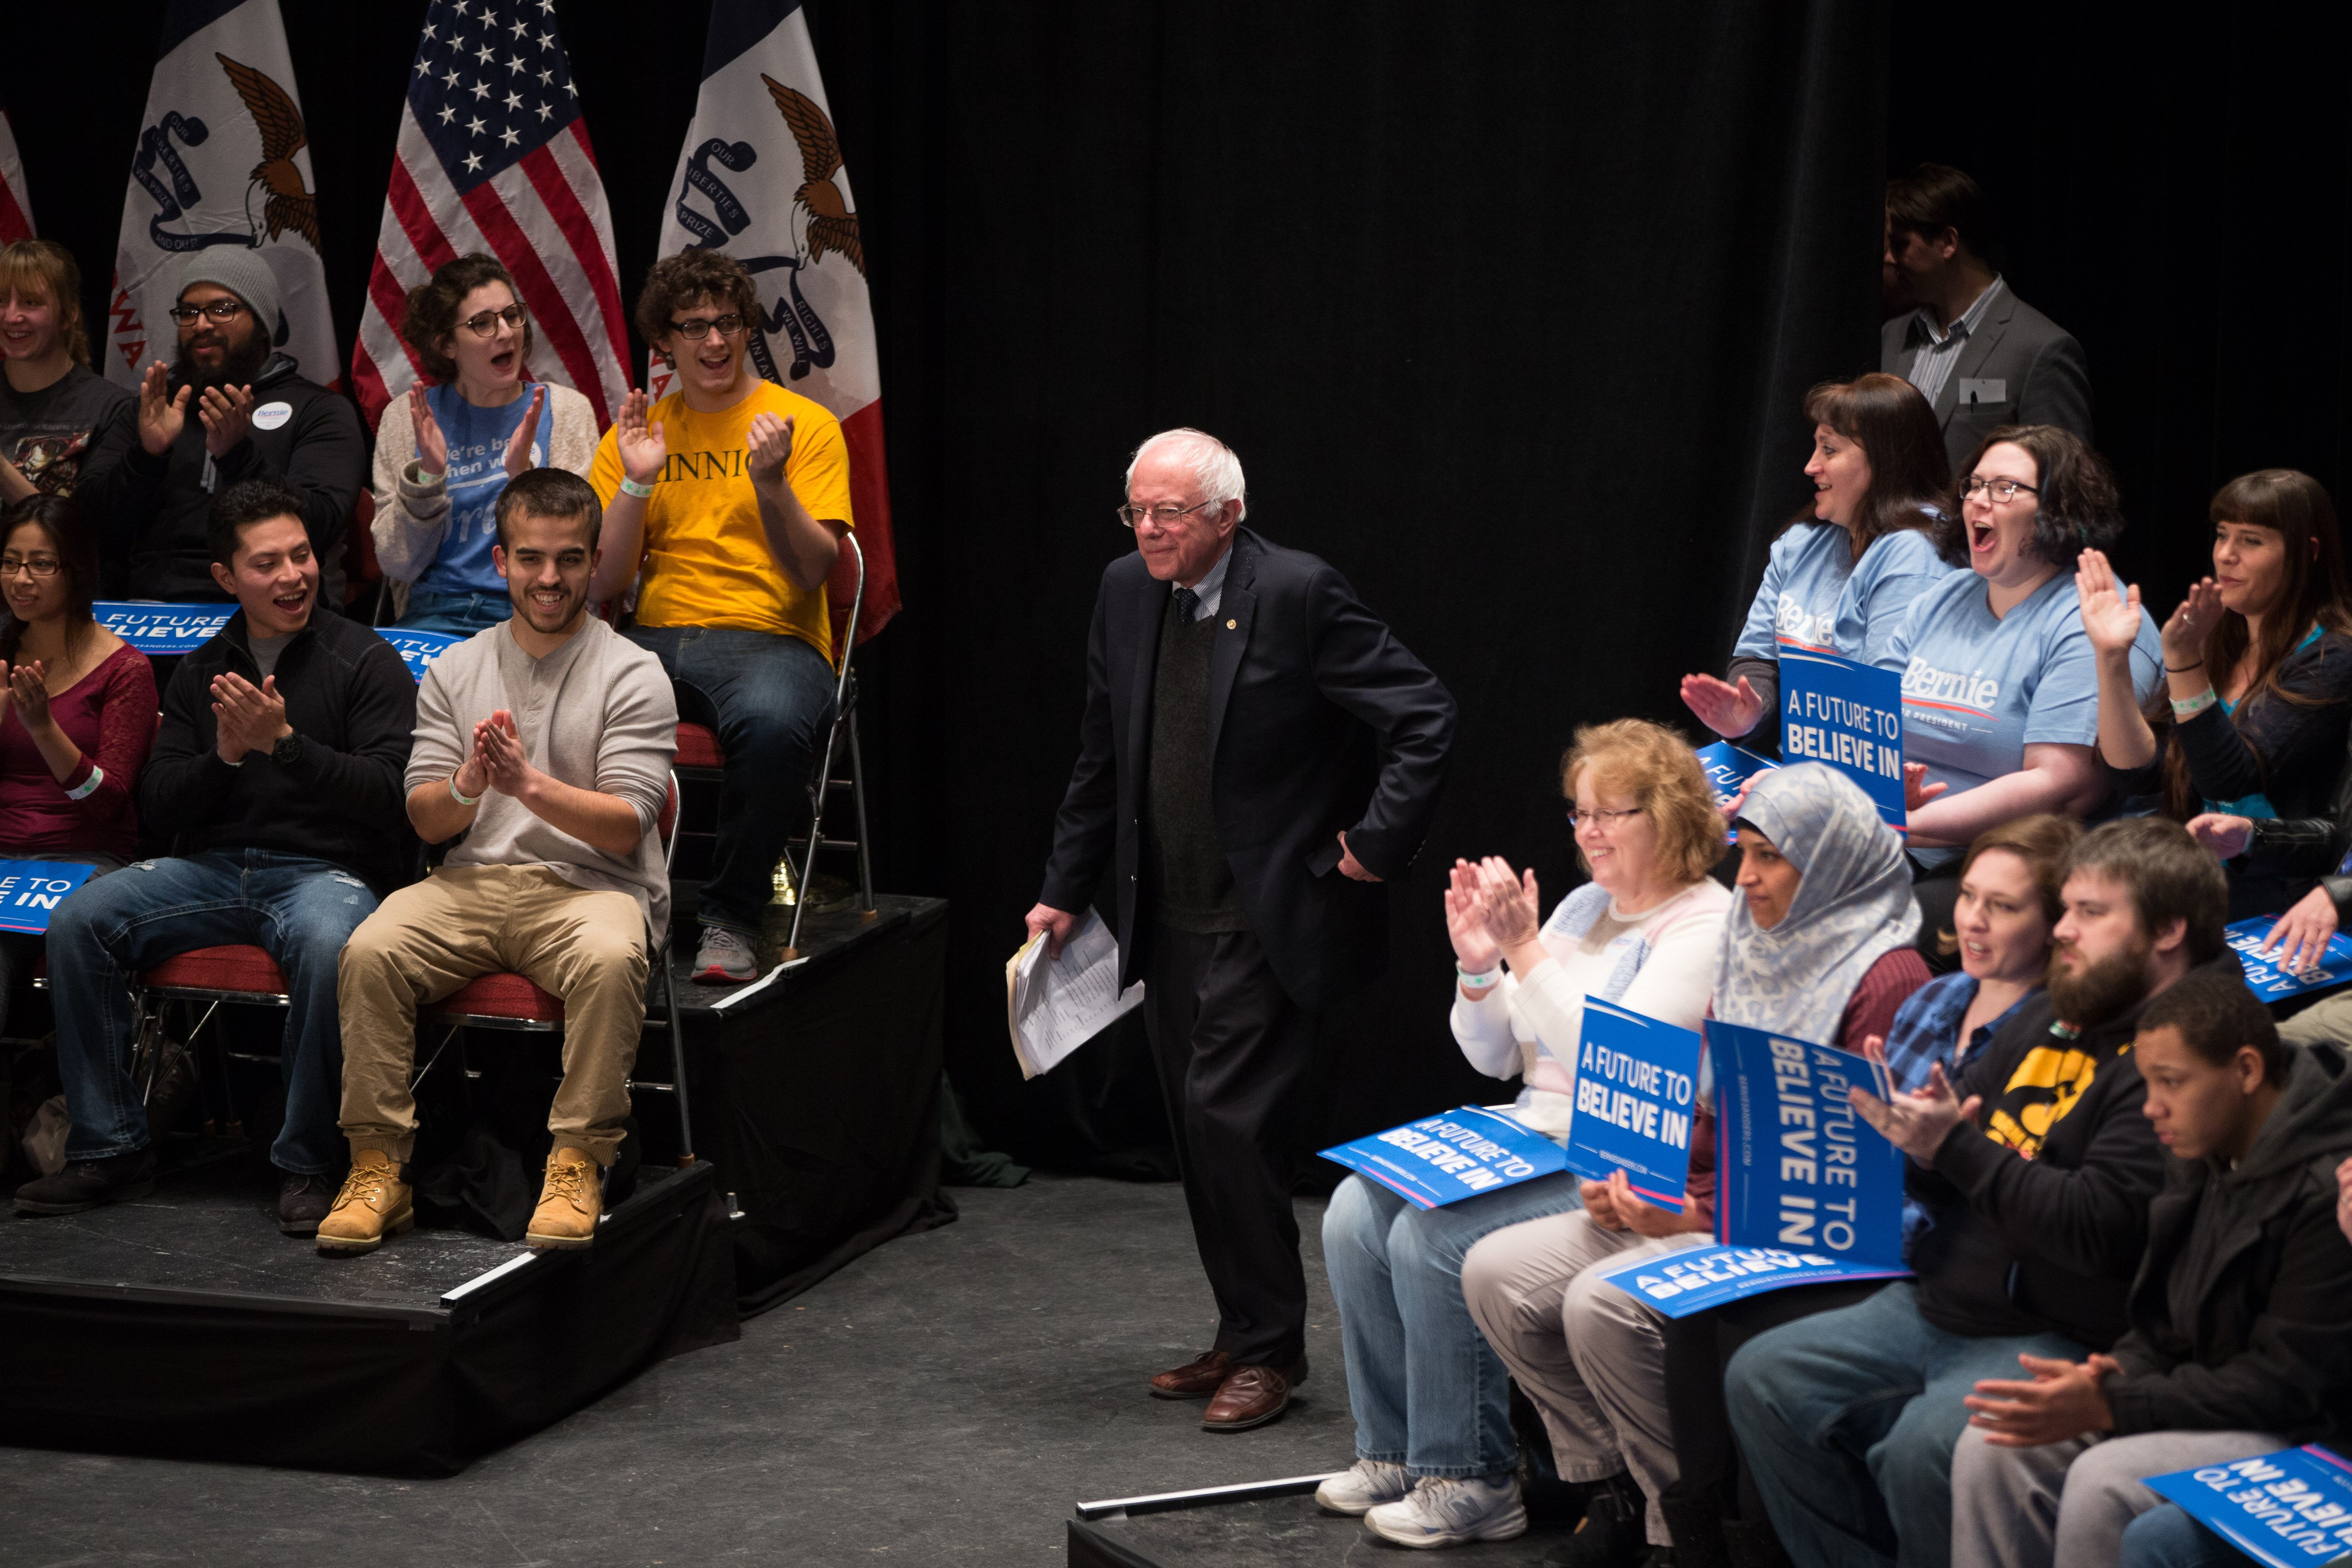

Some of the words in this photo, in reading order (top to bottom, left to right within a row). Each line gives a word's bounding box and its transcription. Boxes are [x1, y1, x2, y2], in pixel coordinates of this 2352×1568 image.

[170, 116, 189, 139] OUR
[711, 142, 735, 166] OUR
[687, 167, 739, 218] IBERTIES
[156, 234, 173, 249] AND
[680, 210, 715, 238] PRIZE
[110, 268, 147, 371] WA
[782, 309, 799, 332] WE
[793, 332, 807, 367] WILL
[796, 301, 829, 350] RIGHTS
[446, 444, 486, 461] e're
[447, 461, 482, 478] hen
[654, 449, 751, 484] INNI
[106, 613, 232, 626] FUTURE
[1900, 656, 1999, 709] Bernie
[1788, 689, 1802, 716] A
[1806, 692, 1872, 733] FUTURE
[1874, 710, 1898, 740] TO
[1913, 712, 1968, 731] PRESIDENT
[1788, 723, 1875, 773] BELIEVE
[1878, 745, 1900, 781] IN
[14, 892, 62, 910] IN
[30, 878, 72, 892] TO
[2266, 979, 2297, 992] A
[1581, 1041, 1593, 1071] A
[1595, 1045, 1662, 1096] FUTURE
[1664, 1069, 1693, 1106] TO
[1812, 1048, 1844, 1067] A
[1577, 1077, 1660, 1140] BELIEVE
[1661, 1108, 1689, 1150] IN
[1769, 1037, 1817, 1185] BELIEVE
[1817, 1070, 1857, 1188] FUTURE
[1377, 1127, 1478, 1174] BELIEVE
[1455, 1166, 1504, 1190] IN
[1414, 1118, 1444, 1131] A
[1436, 1121, 1510, 1162] FUTURE
[1495, 1154, 1535, 1178] TO
[1778, 1194, 1816, 1247] IN
[1822, 1196, 1857, 1251] TO
[1635, 1274, 1665, 1290] A
[1643, 1253, 1835, 1300] BELIEVE
[2193, 1466, 2242, 1493] TO
[2228, 1458, 2286, 1483] IN
[2226, 1487, 2342, 1555] FUTURE
[2264, 1478, 2352, 1546] LIEVE
